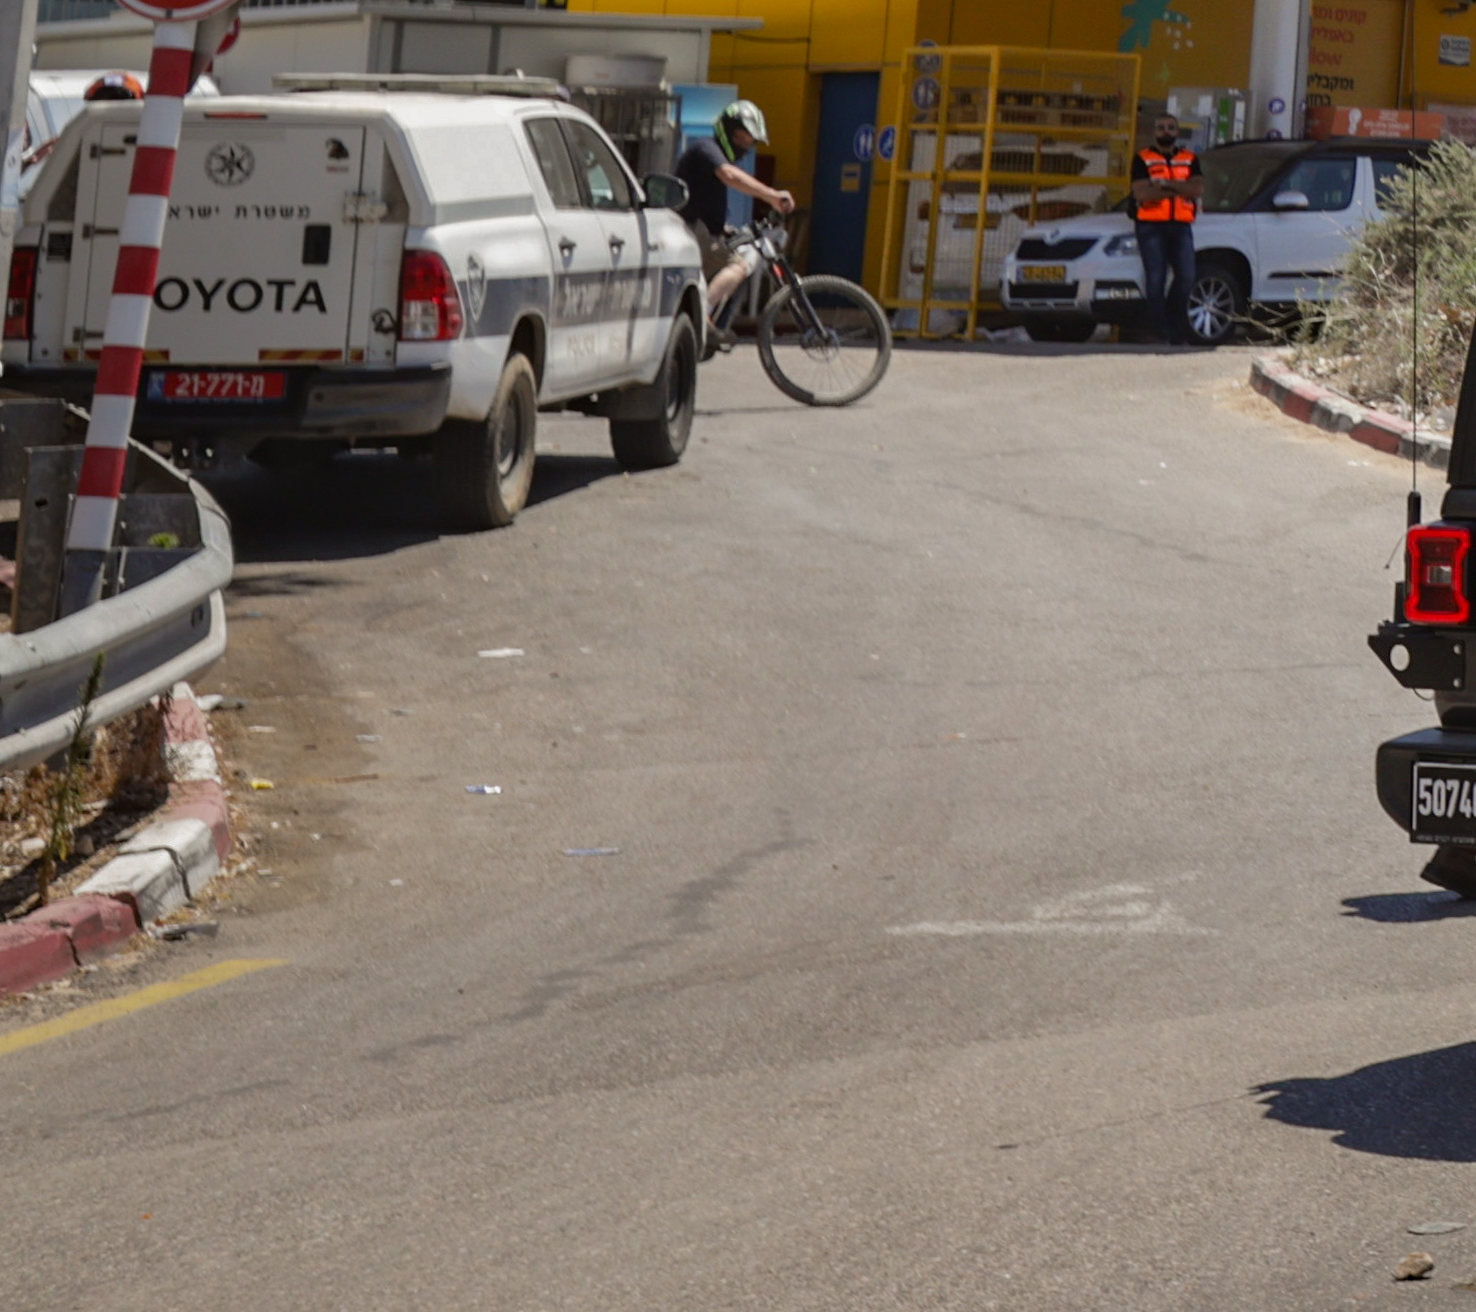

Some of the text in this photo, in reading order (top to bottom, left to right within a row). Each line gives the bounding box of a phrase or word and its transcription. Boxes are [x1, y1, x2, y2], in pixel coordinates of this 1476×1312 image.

[1309, 47, 1342, 65] llow
[1307, 73, 1354, 92] ומקבלי
[168, 205, 311, 219] משטרת ישרא
[154, 278, 327, 313] OYOTA
